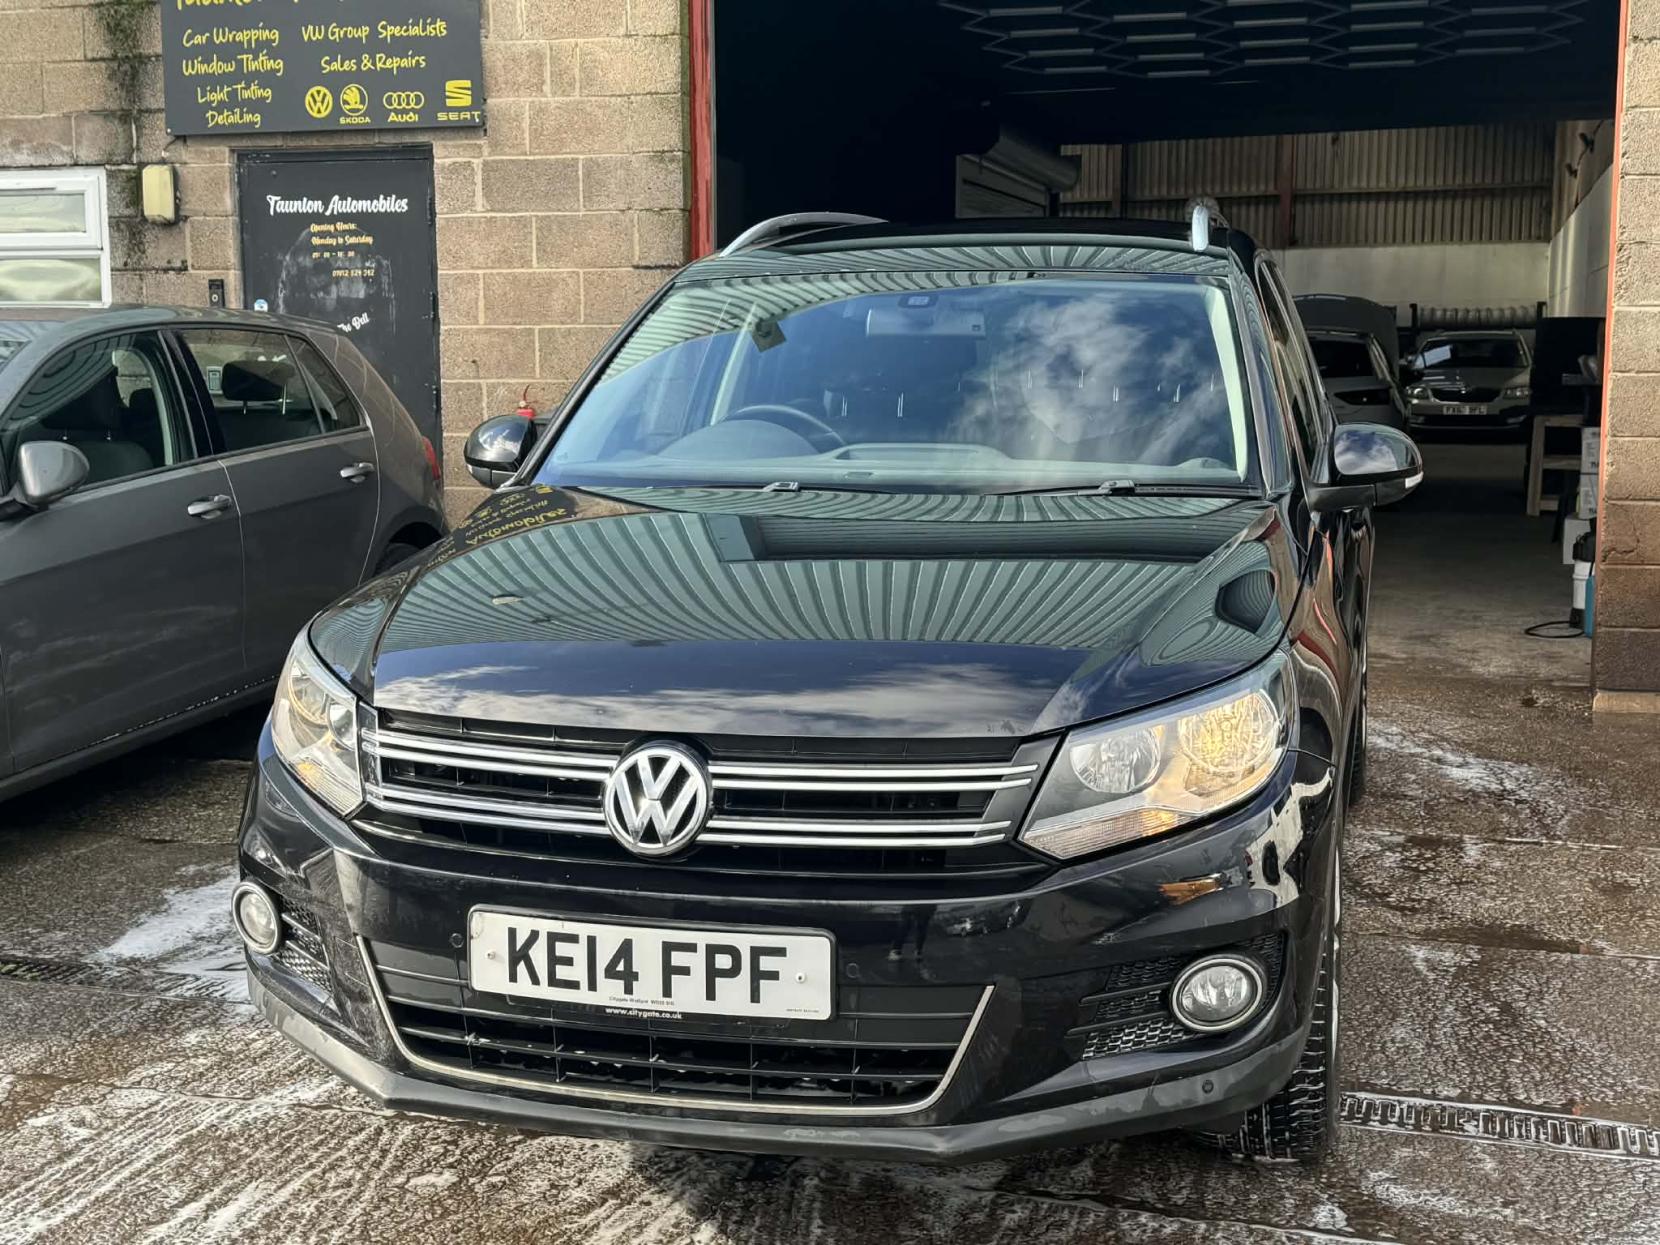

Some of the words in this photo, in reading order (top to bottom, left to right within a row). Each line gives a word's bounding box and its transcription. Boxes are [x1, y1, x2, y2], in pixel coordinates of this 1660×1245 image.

[182, 28, 210, 48] Car
[213, 22, 279, 49] Wrapping
[301, 24, 325, 43] VW
[328, 22, 370, 43] Group
[377, 18, 448, 39] Specialists
[182, 54, 236, 76] Window
[237, 50, 284, 82] Tinting
[321, 54, 357, 73] Sales
[197, 84, 232, 107] Light
[232, 80, 272, 103] Tinting
[205, 107, 261, 128] Detailing
[436, 112, 481, 121] SEAT
[266, 194, 324, 216] Taunton
[325, 194, 408, 216] Automobiles
[507, 926, 640, 996] KE14
[661, 940, 787, 1004] FPF
